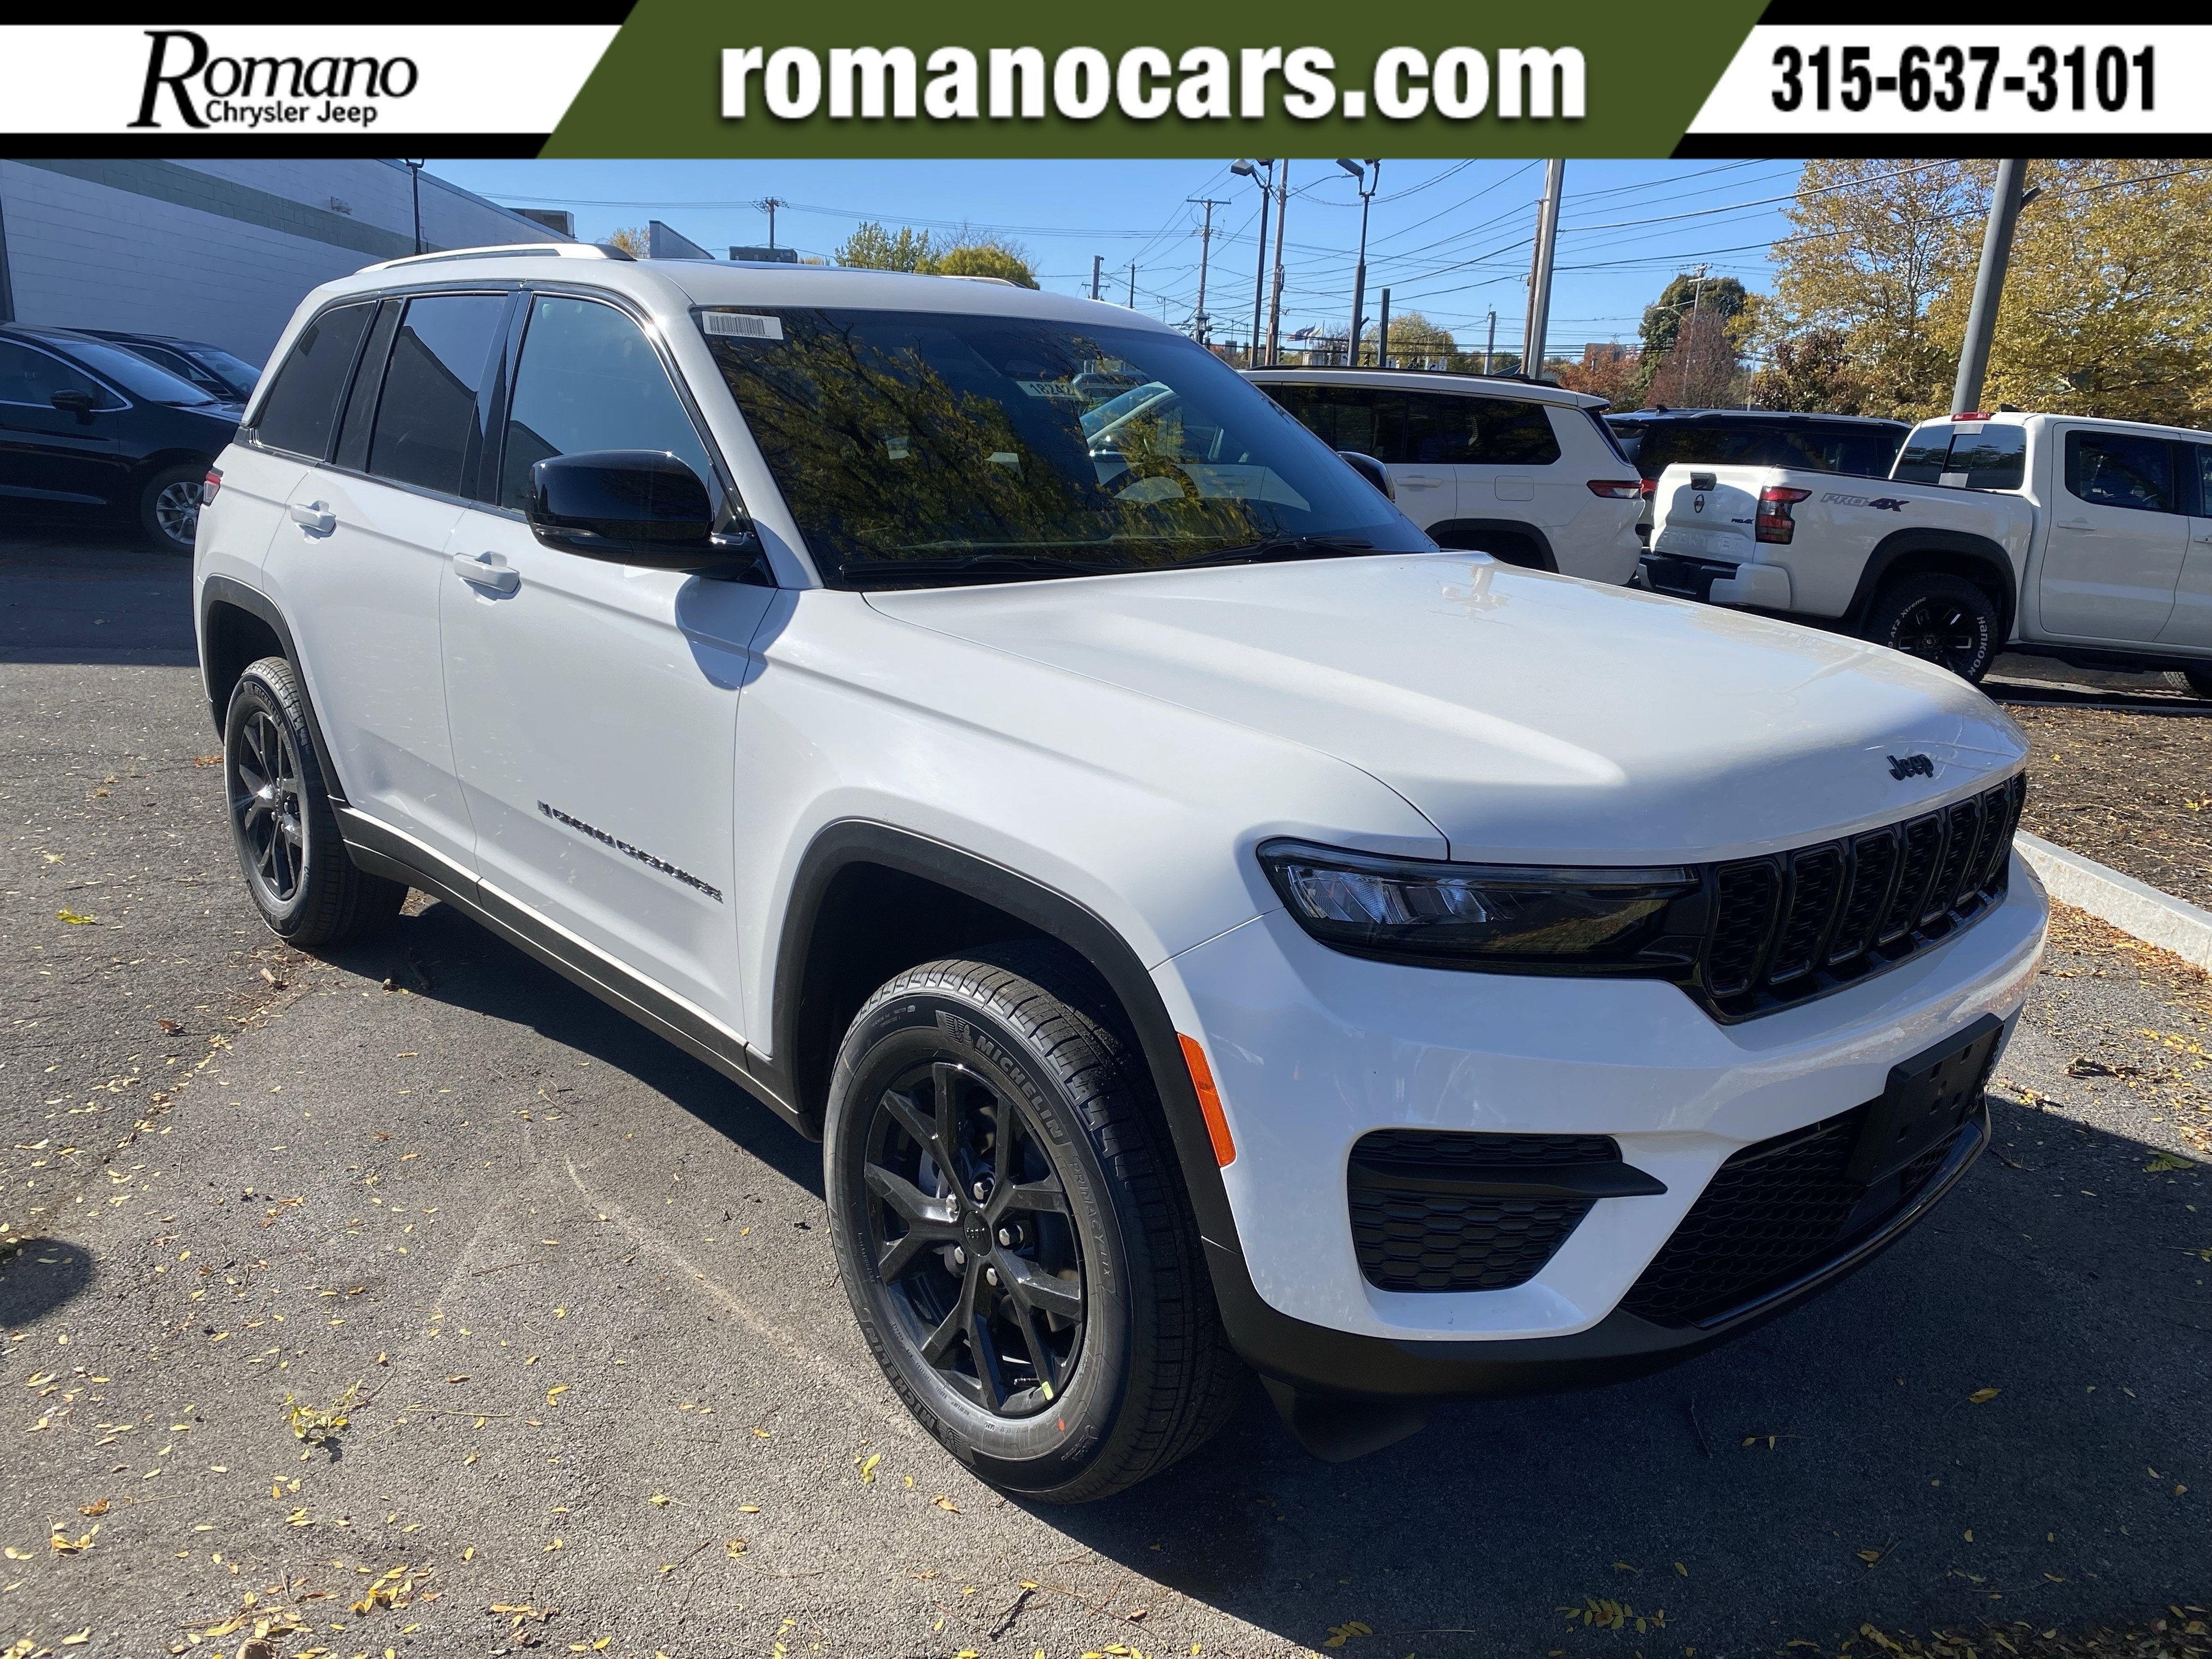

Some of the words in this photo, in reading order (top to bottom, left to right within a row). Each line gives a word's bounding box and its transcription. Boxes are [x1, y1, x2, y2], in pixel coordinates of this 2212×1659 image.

[1886, 753, 1934, 781] Jeep
[975, 1036, 1065, 1145] MICHELIN
[1071, 1160, 1106, 1248] PRIMACY
[1099, 1250, 1113, 1279] LTX
[865, 1327, 939, 1430] MICHELIN
